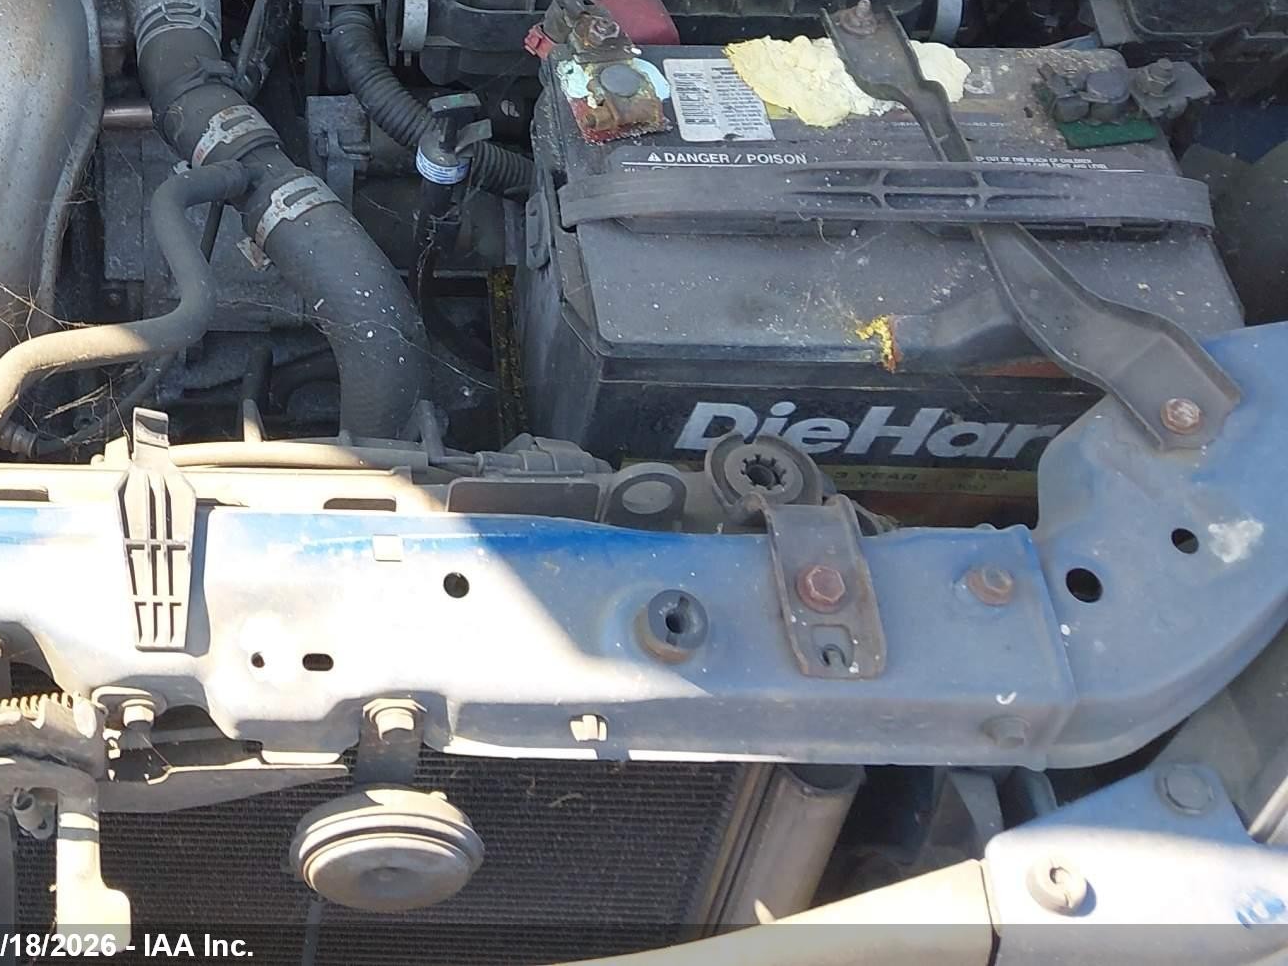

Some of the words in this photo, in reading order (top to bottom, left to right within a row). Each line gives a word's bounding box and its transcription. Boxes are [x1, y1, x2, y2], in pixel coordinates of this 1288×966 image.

[664, 152, 730, 164] DANGER
[734, 153, 742, 164] /
[747, 153, 808, 165] POISON
[673, 400, 1064, 459] DieHar
